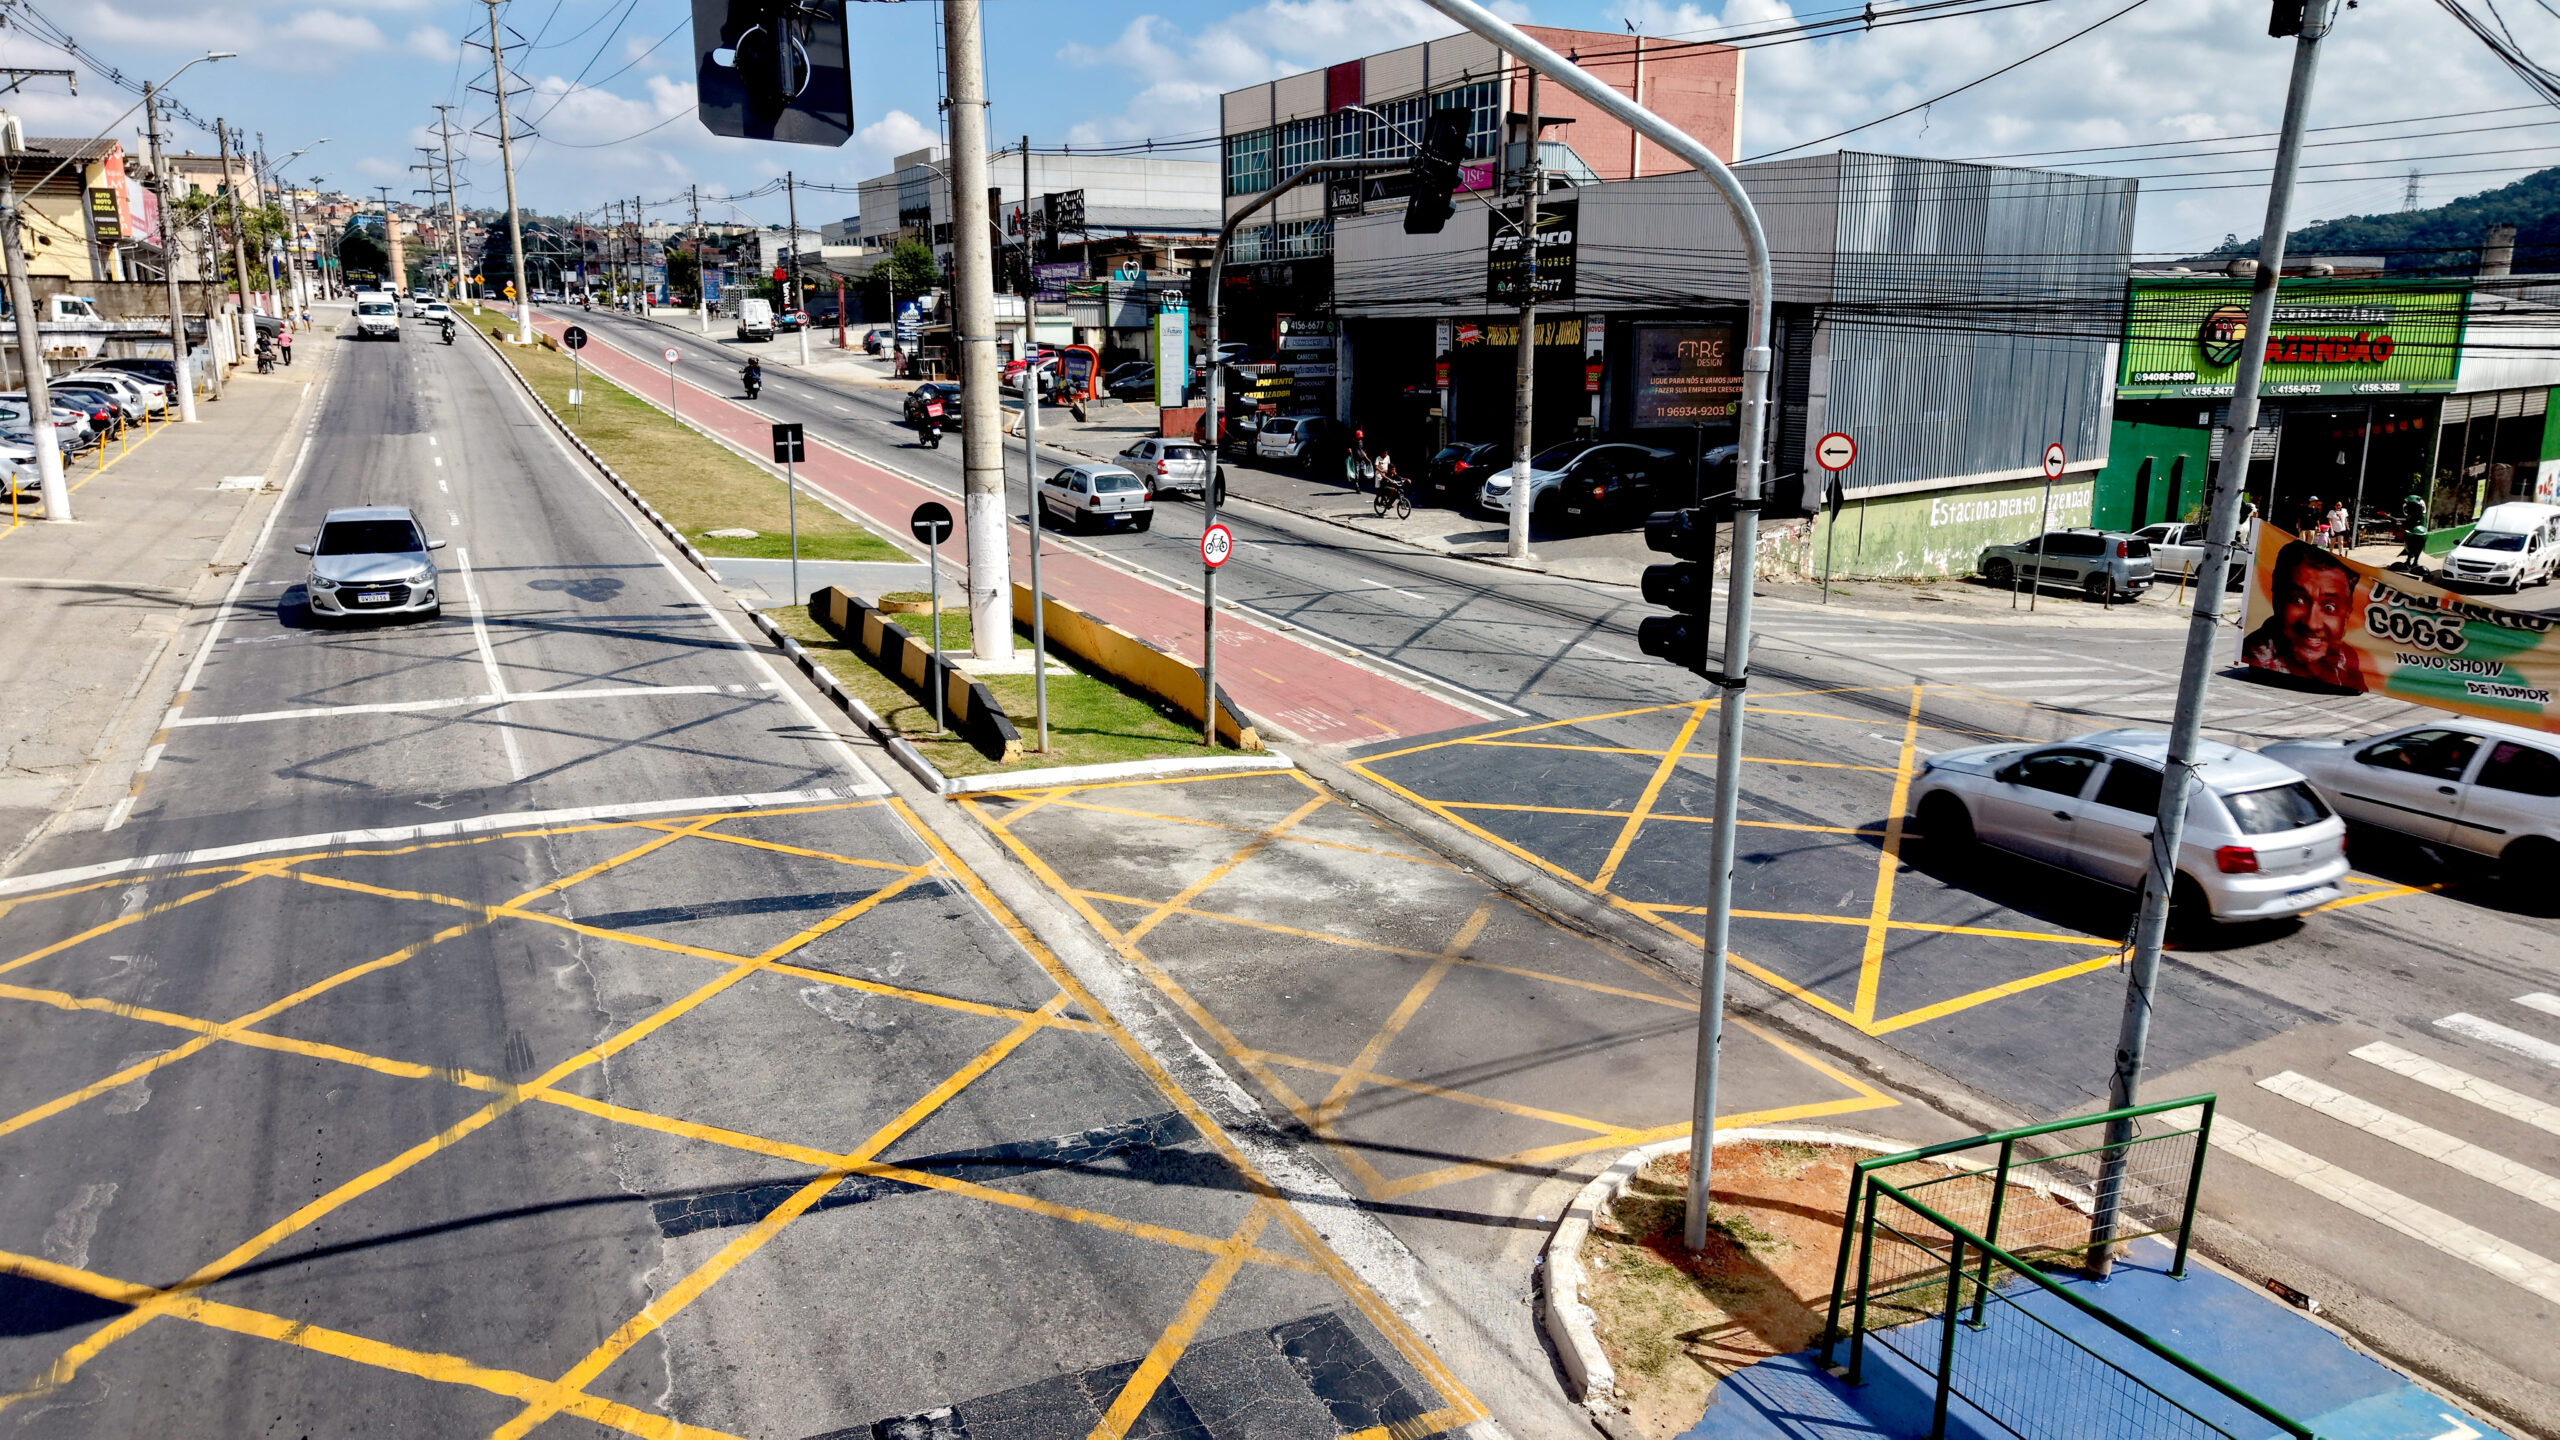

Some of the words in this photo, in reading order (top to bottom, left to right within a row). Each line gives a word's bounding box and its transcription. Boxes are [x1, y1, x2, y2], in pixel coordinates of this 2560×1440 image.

[1339, 193, 1359, 206] FARUS
[1491, 230, 1572, 251] FRNCO
[1290, 320, 1325, 330] 4156-6677
[1555, 319, 1582, 346] JUROS
[2264, 332, 2394, 362] AZENDÃO
[1696, 359, 1723, 367] DESIGN
[1650, 377, 1668, 385] LIGUE
[1686, 375, 1699, 384] NÓS
[1705, 376, 1726, 384] VAMOS
[2142, 372, 2196, 381] 94086-8890
[2190, 386, 2235, 396] 4156-2477
[2359, 383, 2400, 392] 4156-3628
[1657, 408, 1665, 416] 11
[1666, 406, 1725, 417] 96934-9203
[2396, 652, 2444, 669] NOVO
[2449, 658, 2503, 677] SHOW
[2467, 682, 2489, 695] DE
[2491, 684, 2550, 702] HUMOR
